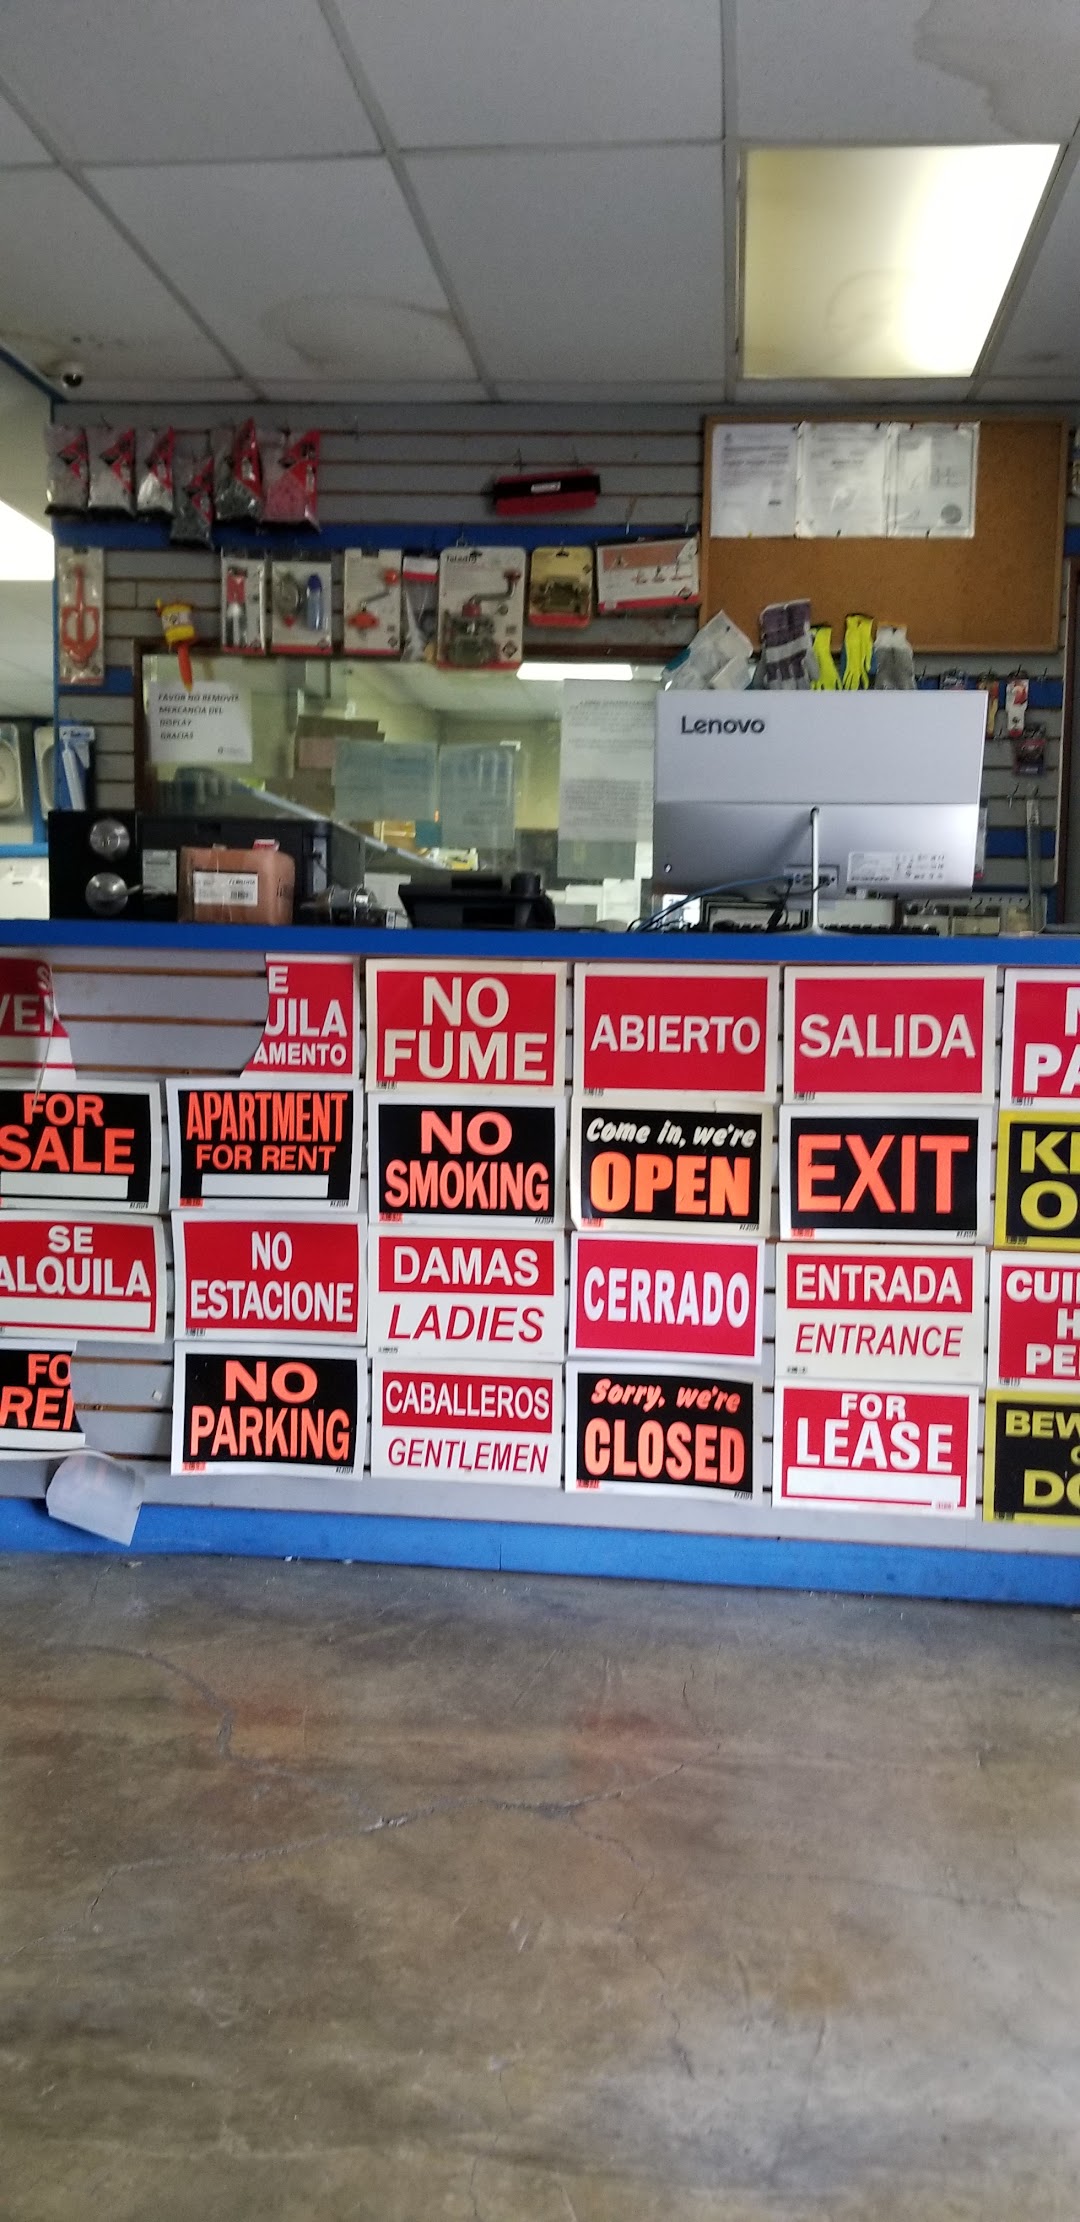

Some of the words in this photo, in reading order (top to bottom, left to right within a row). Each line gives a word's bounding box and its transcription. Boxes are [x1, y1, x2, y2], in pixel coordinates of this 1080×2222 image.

[159, 693, 186, 702] FAVOR
[188, 694, 200, 702] NO
[160, 732, 194, 740] GRACIAS
[681, 715, 765, 734] Lenovo
[423, 976, 510, 1028] NO
[253, 1041, 347, 1067] AMENTO
[383, 1029, 548, 1082] FUME
[589, 1014, 761, 1055] ABIERTO
[799, 1013, 977, 1059] SALIDA
[23, 1092, 104, 1127] FOR
[186, 1091, 348, 1143] APARTMENT
[0, 1124, 135, 1174] SALE
[420, 1110, 512, 1156] NO
[586, 1117, 651, 1144] Come
[656, 1119, 687, 1149] in,
[692, 1123, 757, 1149] we're
[196, 1144, 252, 1171] FOR
[261, 1144, 336, 1172] RENT
[798, 1134, 970, 1214] EXIT
[384, 1158, 549, 1212] SMOKING
[590, 1151, 751, 1217] OPEN
[48, 1225, 94, 1254] SE
[251, 1231, 293, 1271] NO
[0, 1255, 152, 1298] ALQUILA
[393, 1245, 540, 1287] DAMAS
[795, 1263, 963, 1305] ENTRADA
[190, 1279, 354, 1323] ESTACIONE
[583, 1265, 750, 1329] CERRADO
[387, 1304, 545, 1343] LADIES
[795, 1322, 964, 1358] ENTRANCE
[225, 1360, 318, 1404] NO
[385, 1380, 550, 1421] CABALLEROS
[590, 1378, 666, 1413] Sorry,
[676, 1385, 741, 1414] we're
[840, 1392, 907, 1421] FOR
[190, 1405, 350, 1461] PARKING
[584, 1417, 745, 1485] CLOSED
[796, 1416, 953, 1474] LEASE
[387, 1438, 549, 1473] GENTLEMEN
